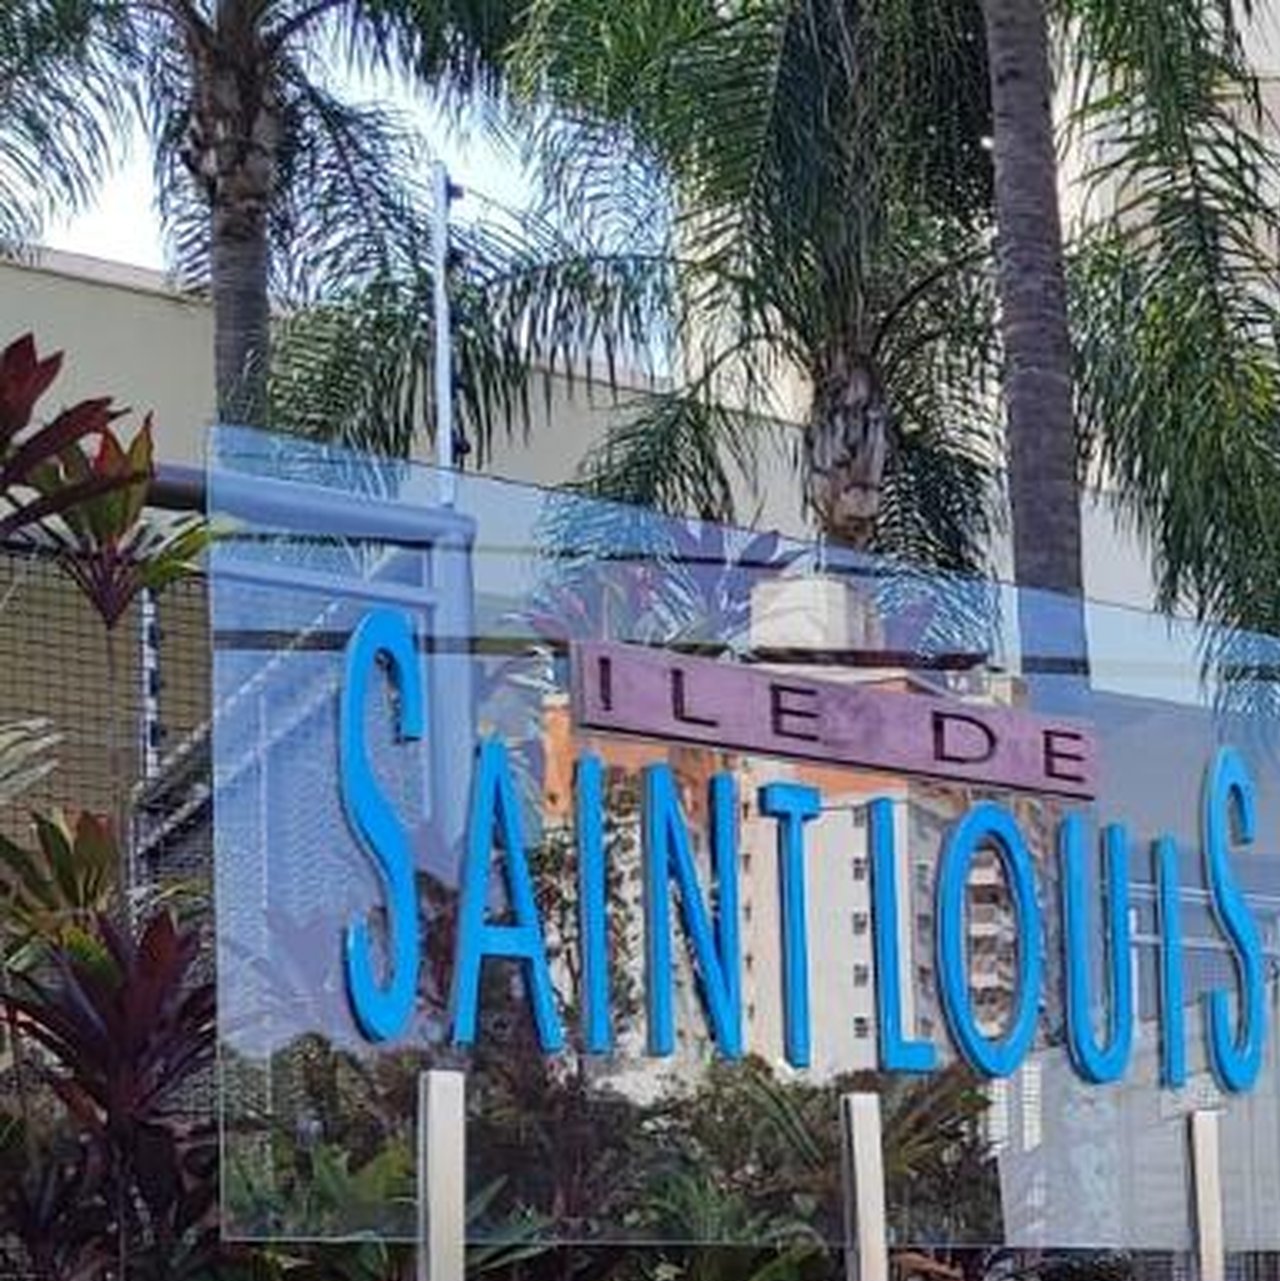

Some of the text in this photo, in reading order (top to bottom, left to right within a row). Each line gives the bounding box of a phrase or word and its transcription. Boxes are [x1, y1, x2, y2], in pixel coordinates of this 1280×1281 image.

[341, 610, 1267, 1093] SAINT LOUIS
[598, 657, 1087, 782] ILE DE
